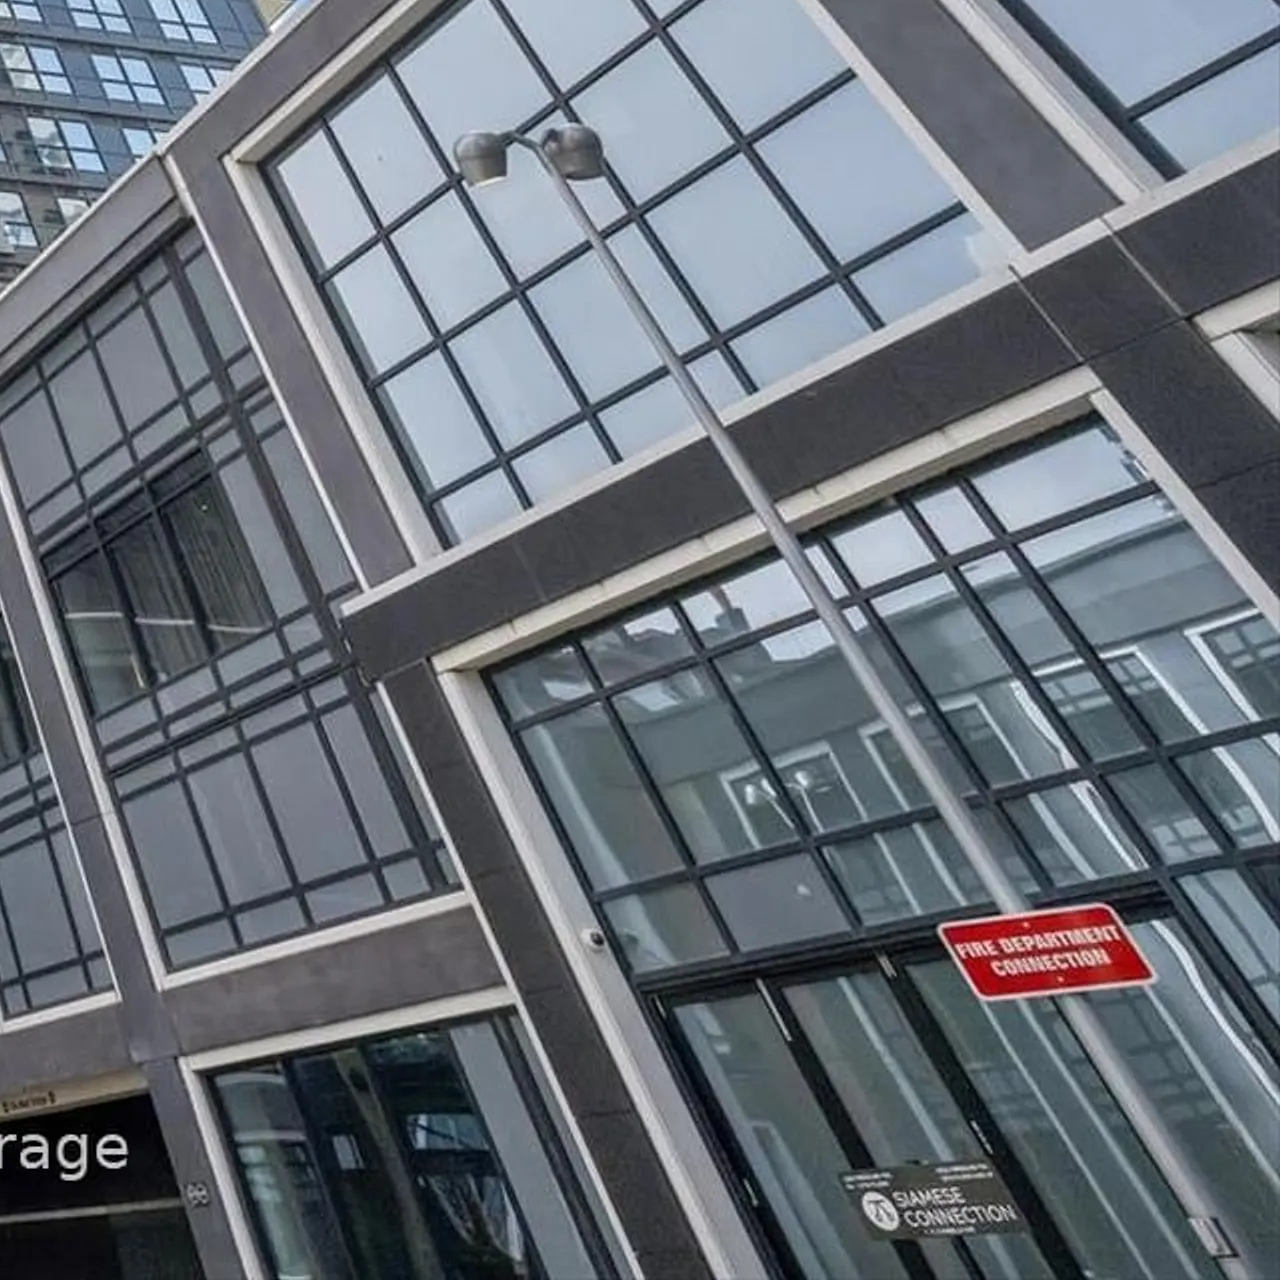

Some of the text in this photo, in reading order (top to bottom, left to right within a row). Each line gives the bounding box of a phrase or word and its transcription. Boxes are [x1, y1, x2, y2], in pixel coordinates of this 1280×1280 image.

[954, 924, 1122, 960] FIRE DEPARTMENT
[990, 947, 1112, 977] CONNECTION
[892, 1186, 967, 1208] SIAMESE
[903, 1204, 1018, 1228] CONNECTION
